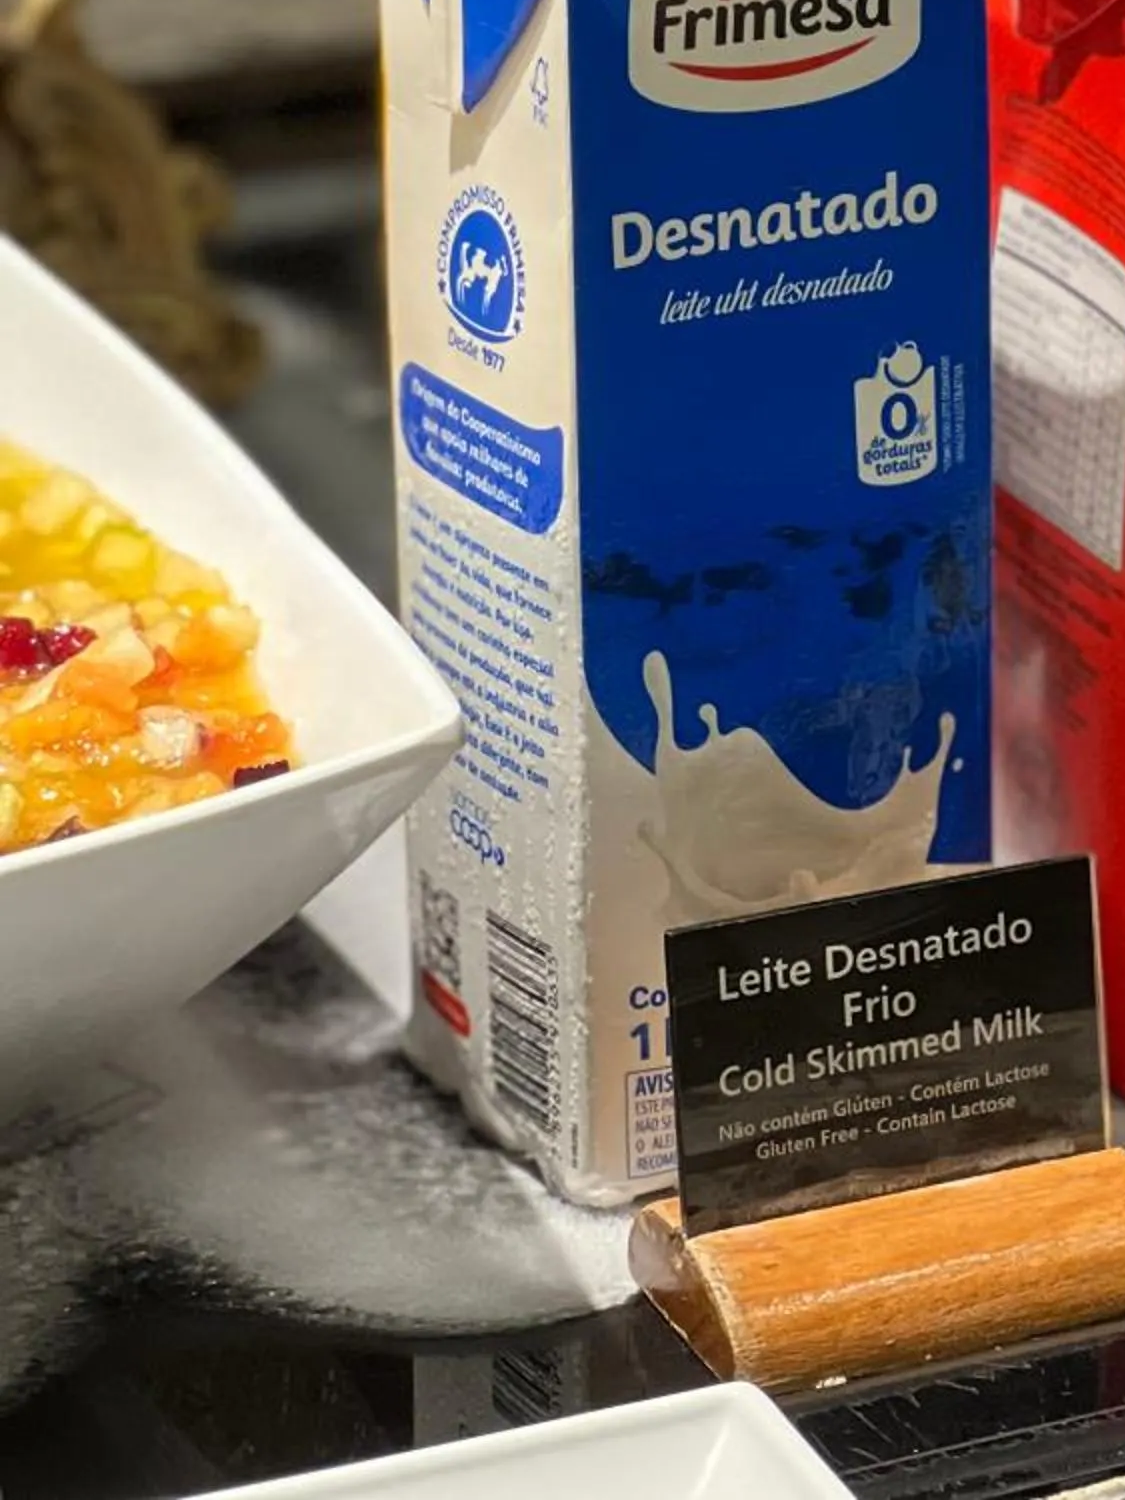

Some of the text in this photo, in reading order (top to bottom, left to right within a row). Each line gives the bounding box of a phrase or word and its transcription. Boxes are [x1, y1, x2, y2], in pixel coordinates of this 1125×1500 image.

[610, 171, 939, 271] Desnatado
[660, 258, 895, 326] leite uht desnatado
[863, 440, 932, 465] gorduras
[717, 911, 1033, 1001] Leite Desnatado
[629, 986, 667, 1009] Co
[842, 985, 917, 1027] Frio
[719, 1005, 1044, 1096] Cold Skimmed Milk
[635, 1072, 674, 1097] AVIS
[719, 1121, 755, 1143] Não
[761, 1106, 828, 1134] contém
[833, 1093, 892, 1118] Glúten
[911, 1076, 980, 1103] Contém
[985, 1061, 1050, 1088] Lactose
[756, 1137, 815, 1160] Gluten
[821, 1127, 858, 1147] Free
[877, 1108, 946, 1135] Contain
[951, 1093, 1017, 1121] Lactose
